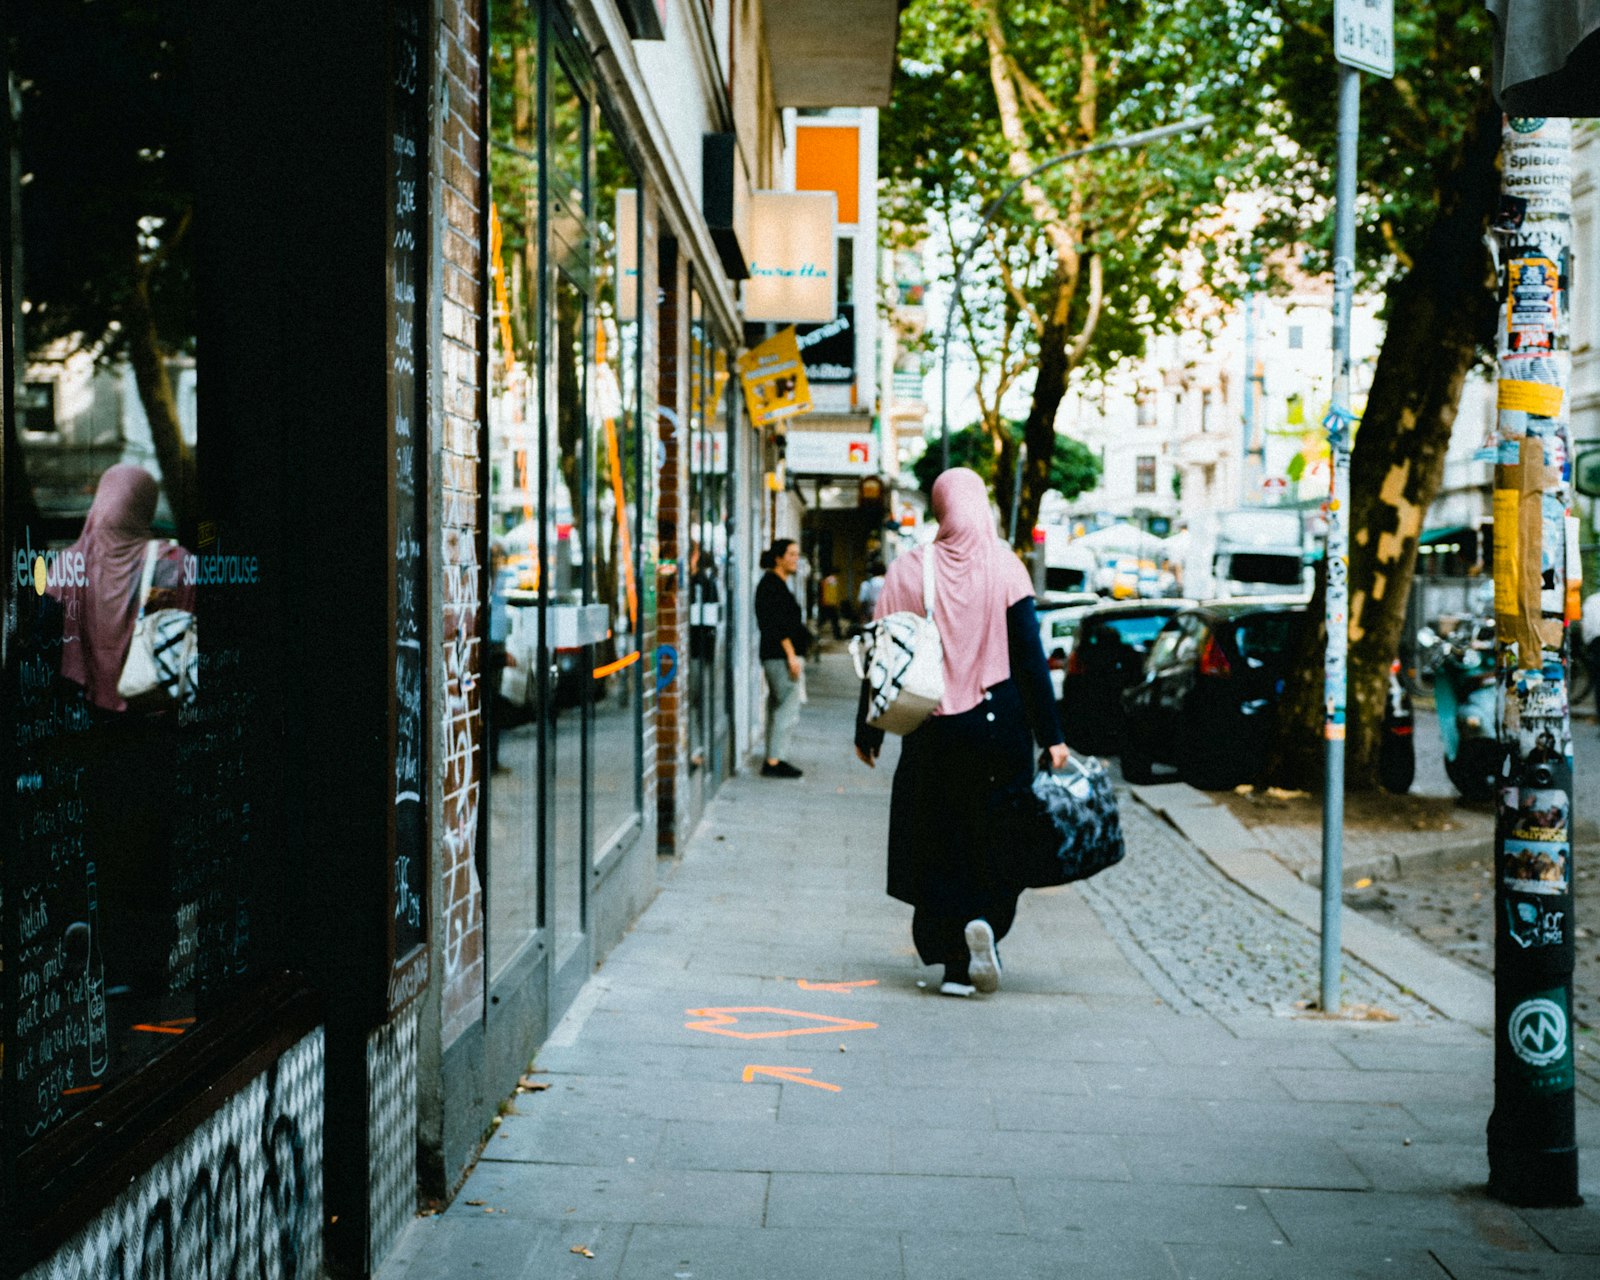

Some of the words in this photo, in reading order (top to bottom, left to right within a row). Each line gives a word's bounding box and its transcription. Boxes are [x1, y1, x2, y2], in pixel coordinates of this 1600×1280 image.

[1510, 154, 1561, 169] Spieler
[16, 524, 90, 587] ebause.
[183, 536, 261, 586] sausebrause.
